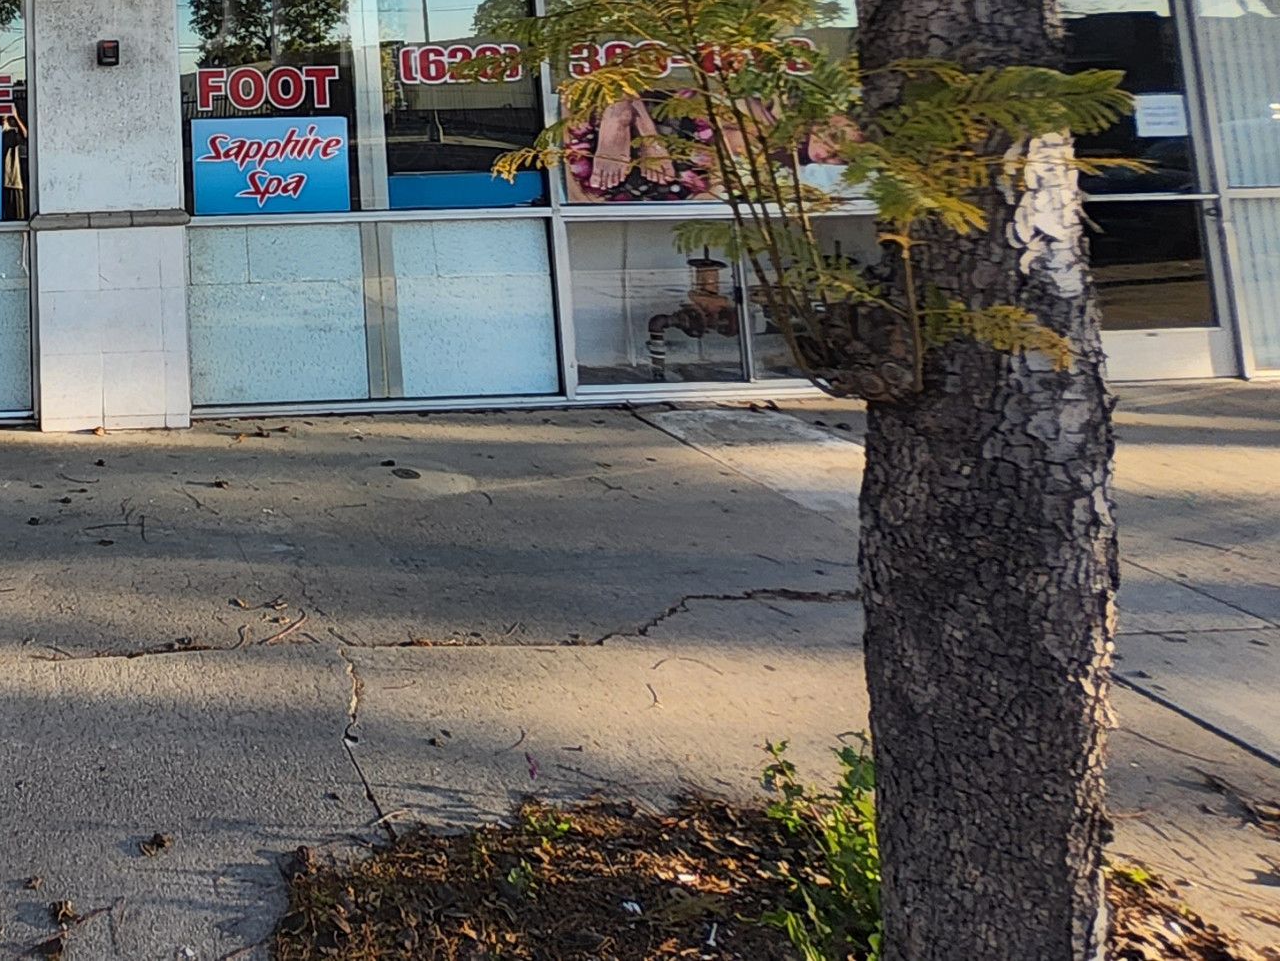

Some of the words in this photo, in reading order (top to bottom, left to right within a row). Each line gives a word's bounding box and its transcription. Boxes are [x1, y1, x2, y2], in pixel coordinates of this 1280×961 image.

[197, 66, 340, 111] FOOT
[195, 124, 343, 171] Sapphire
[234, 169, 308, 208] Spa
